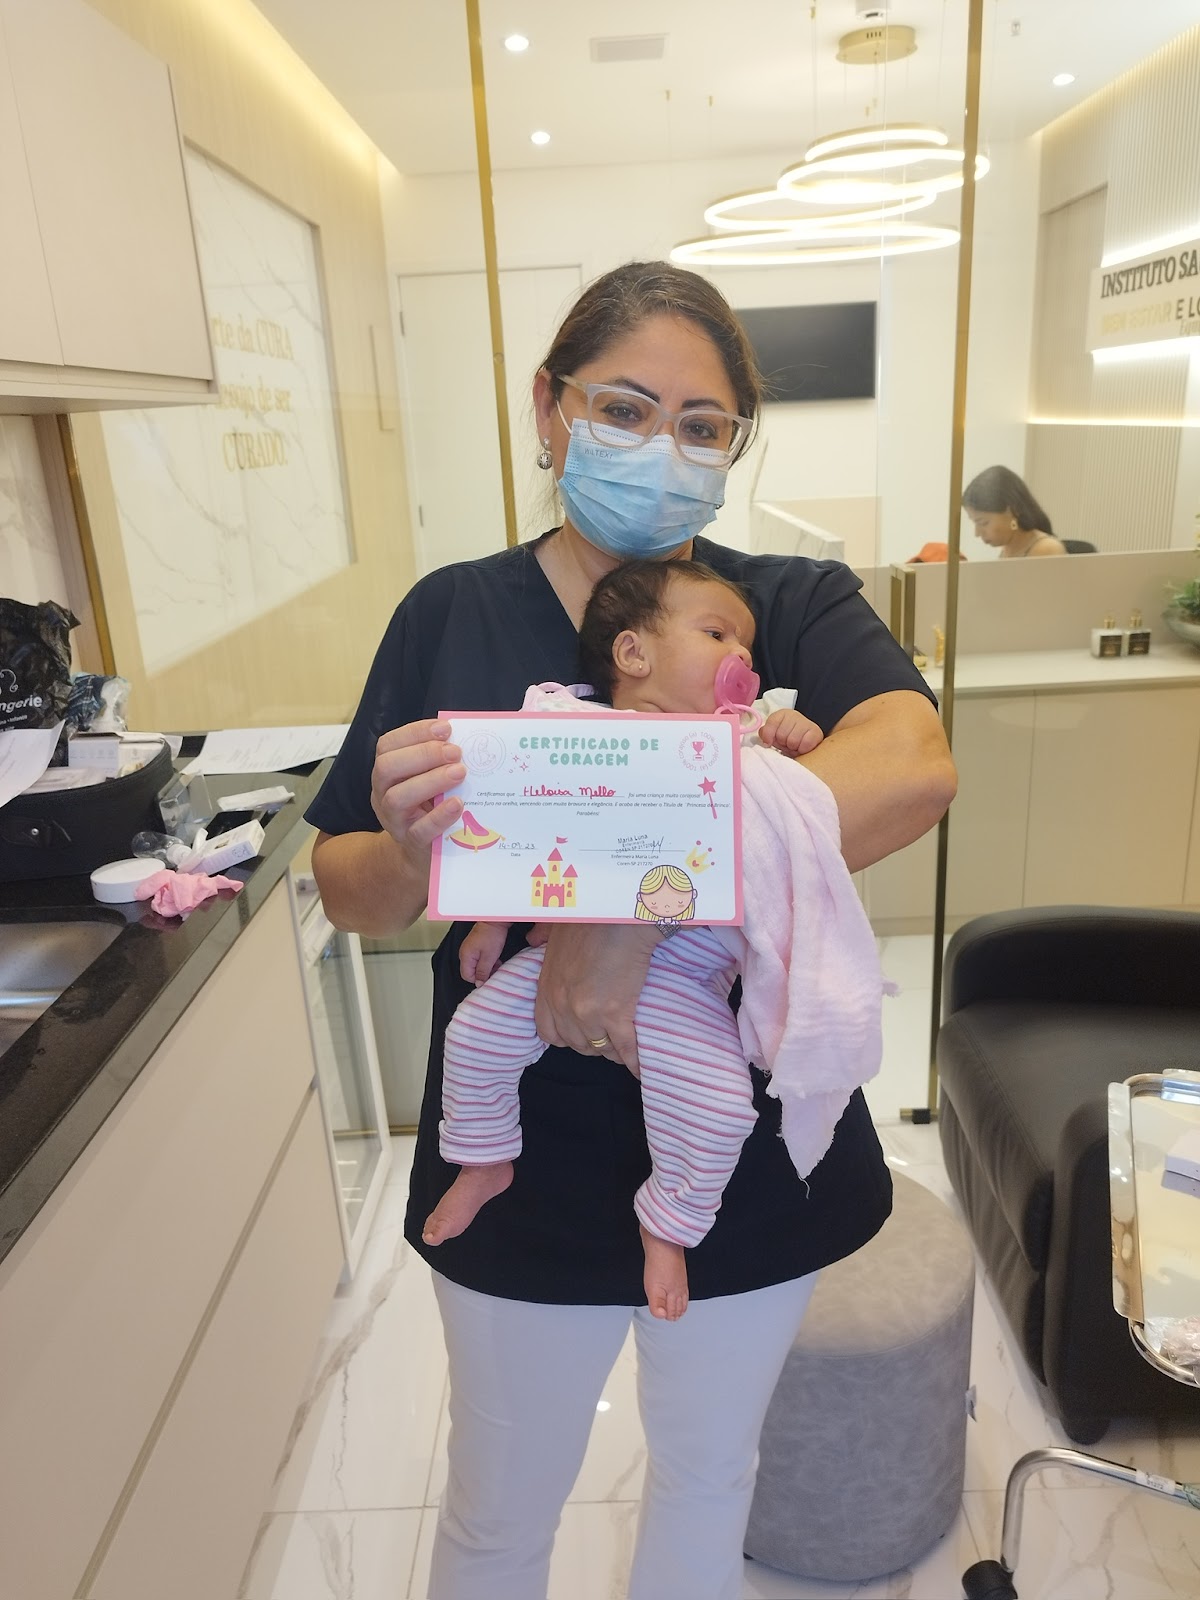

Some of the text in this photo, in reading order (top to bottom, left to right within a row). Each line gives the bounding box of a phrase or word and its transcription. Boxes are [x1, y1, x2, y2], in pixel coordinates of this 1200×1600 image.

[1100, 256, 1176, 299] INSTITUTO
[1175, 298, 1185, 320] E
[256, 318, 295, 361] CURA
[519, 736, 659, 751] CERTIFICADO DE
[549, 752, 629, 767] CORAGEM
[578, 785, 616, 799] Mello
